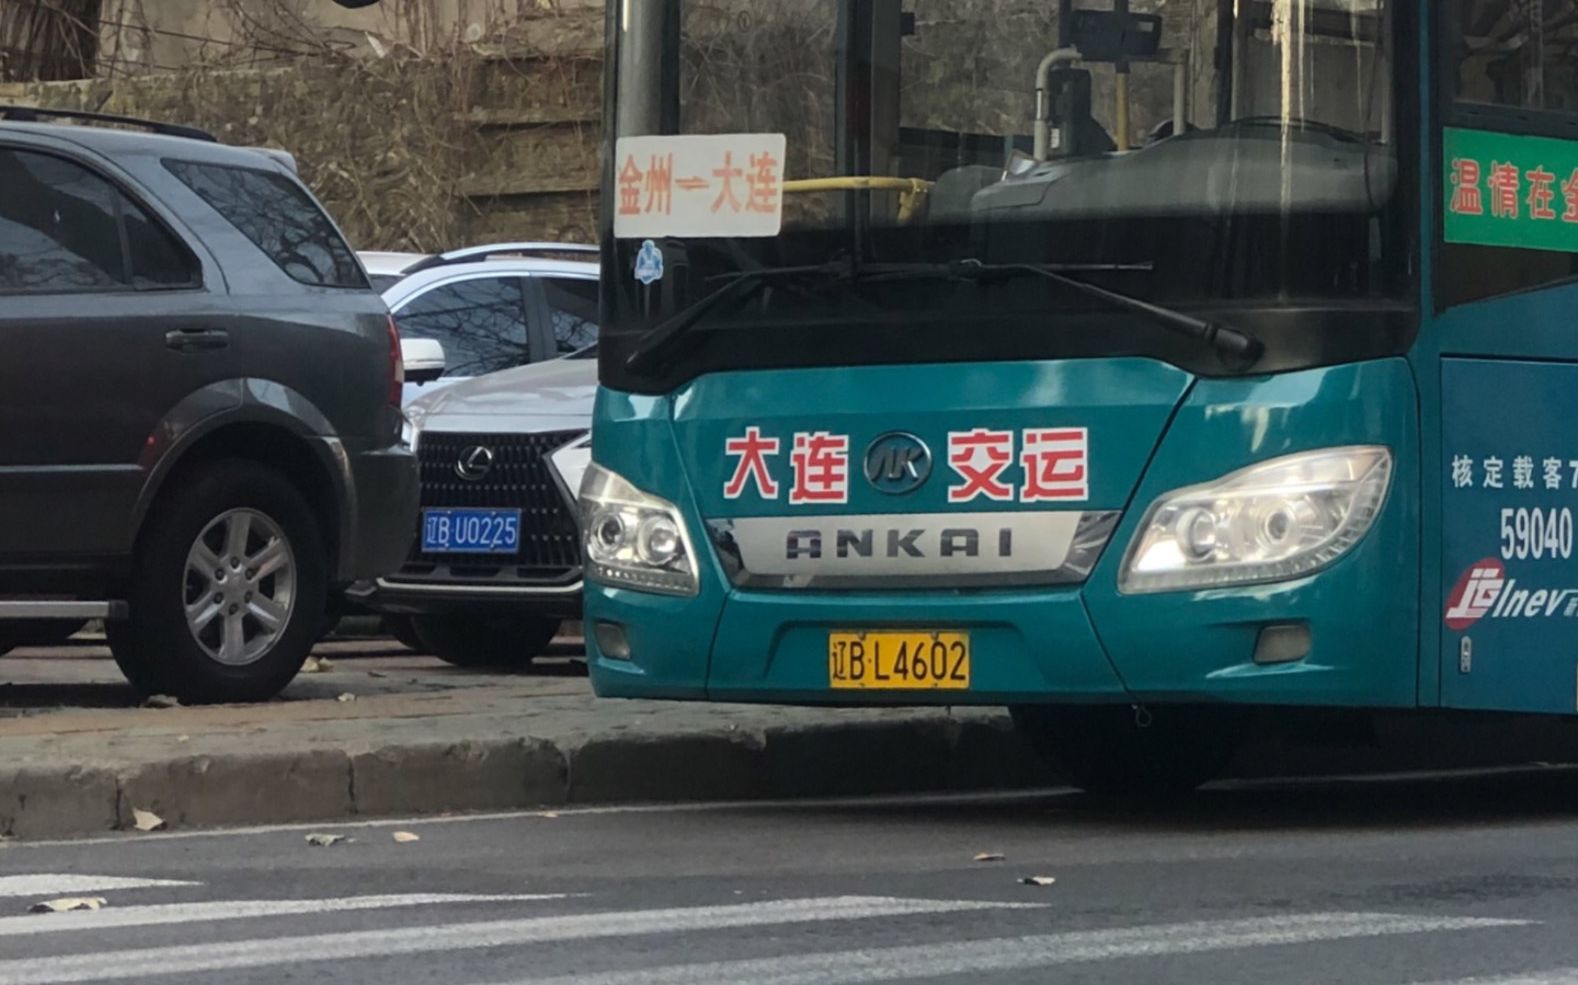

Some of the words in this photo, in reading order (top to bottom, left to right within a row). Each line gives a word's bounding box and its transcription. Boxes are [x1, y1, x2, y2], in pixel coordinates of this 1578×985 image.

[723, 425, 849, 504] 大连
[947, 426, 1089, 503] 交运
[785, 527, 1013, 560] ANKAI
[1500, 507, 1573, 560] 59040
